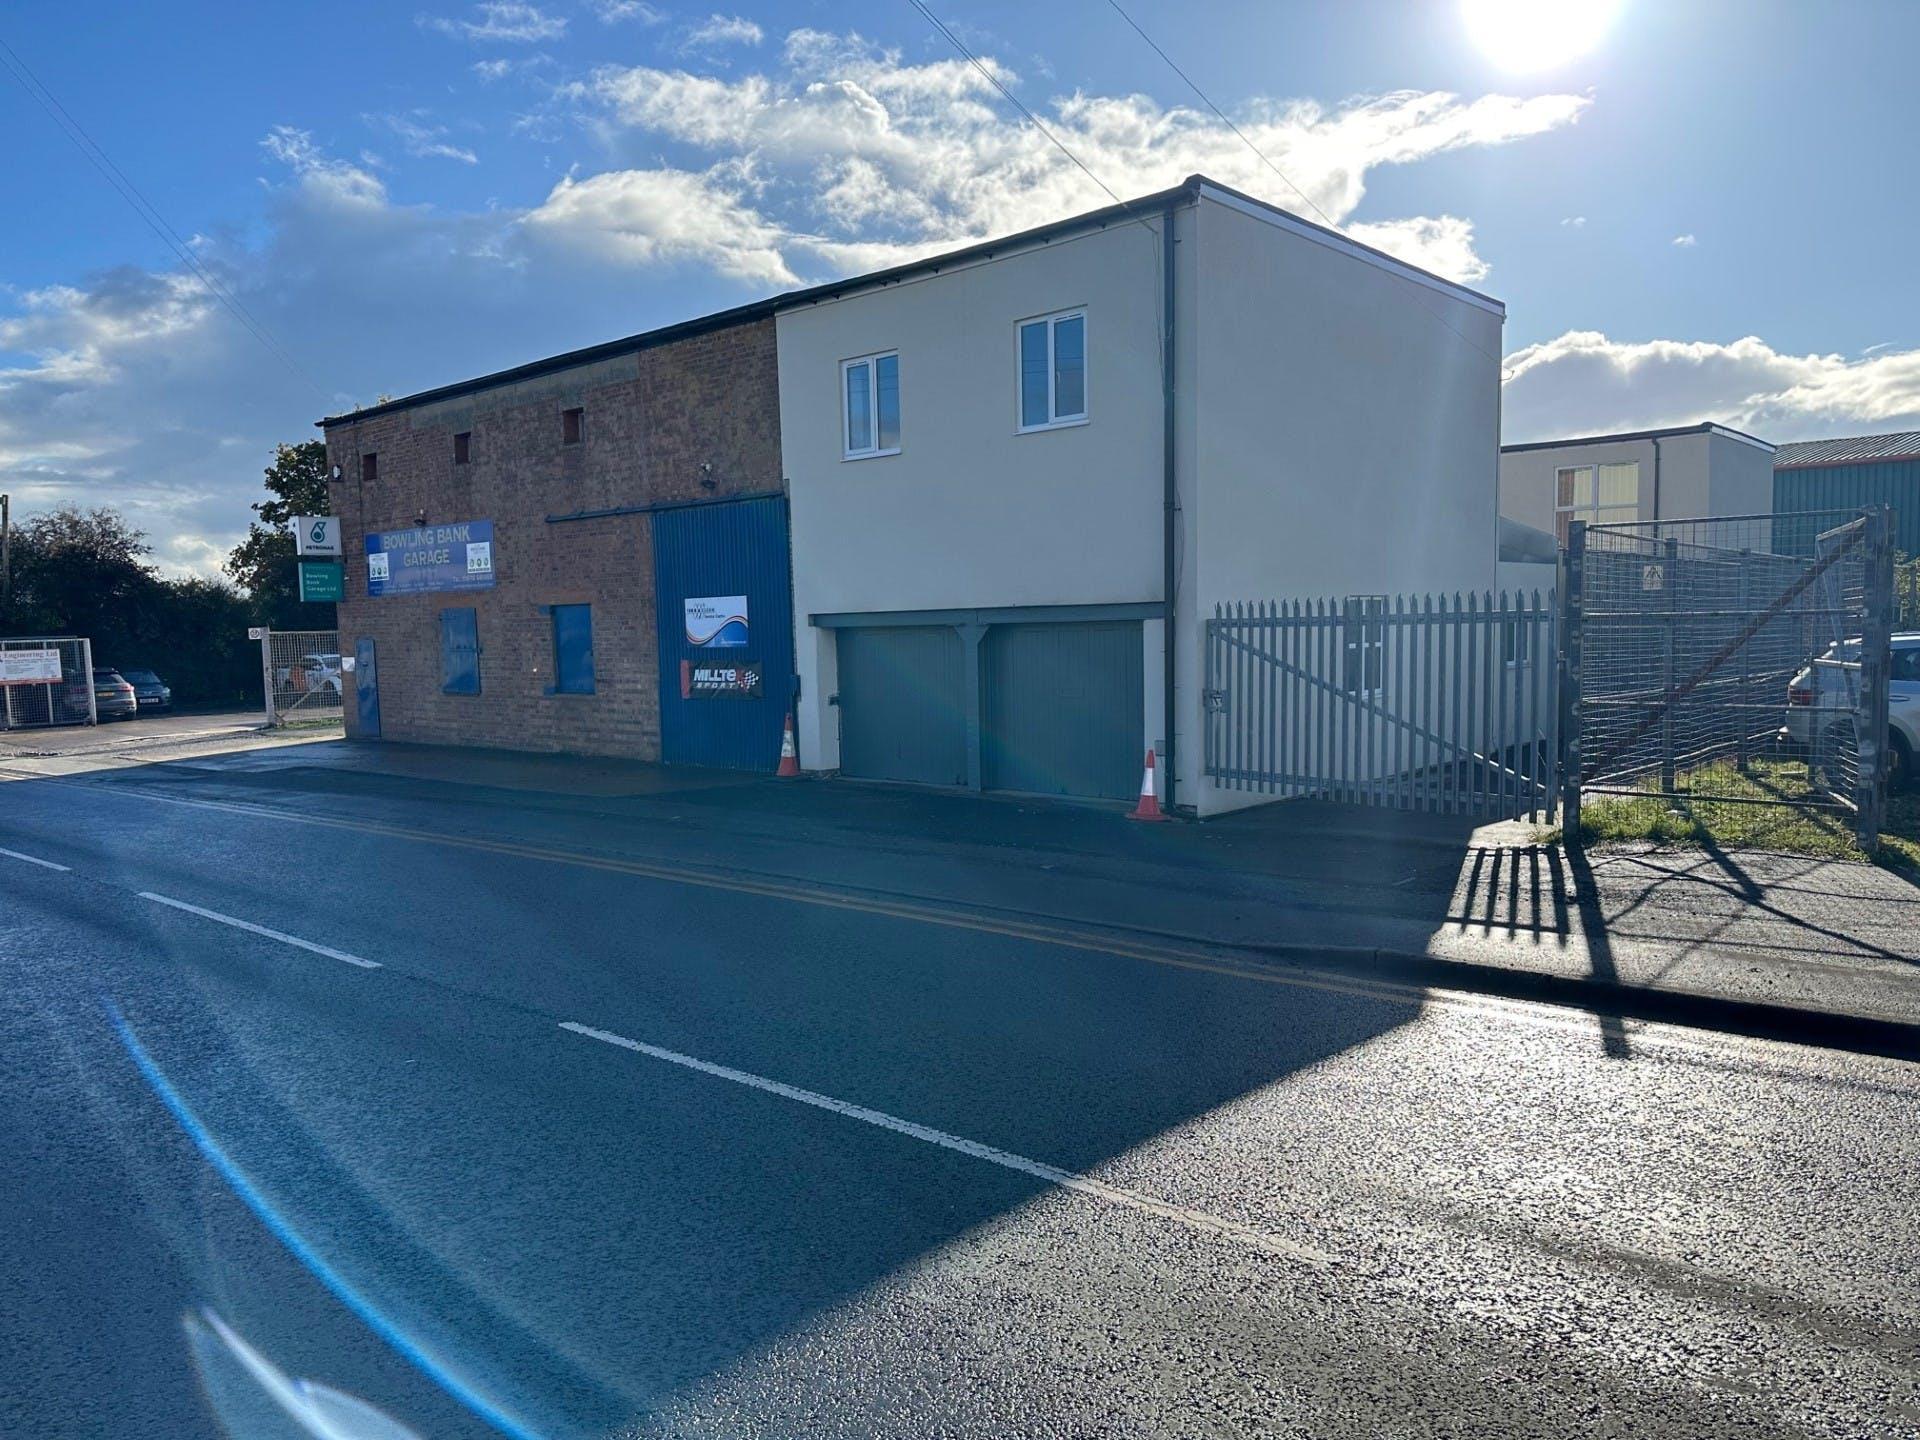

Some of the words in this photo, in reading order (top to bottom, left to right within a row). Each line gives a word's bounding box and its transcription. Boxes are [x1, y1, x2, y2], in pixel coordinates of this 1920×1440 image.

[383, 529, 434, 549] BOWLING
[437, 525, 471, 544] BANK
[403, 549, 450, 567] GARAGE
